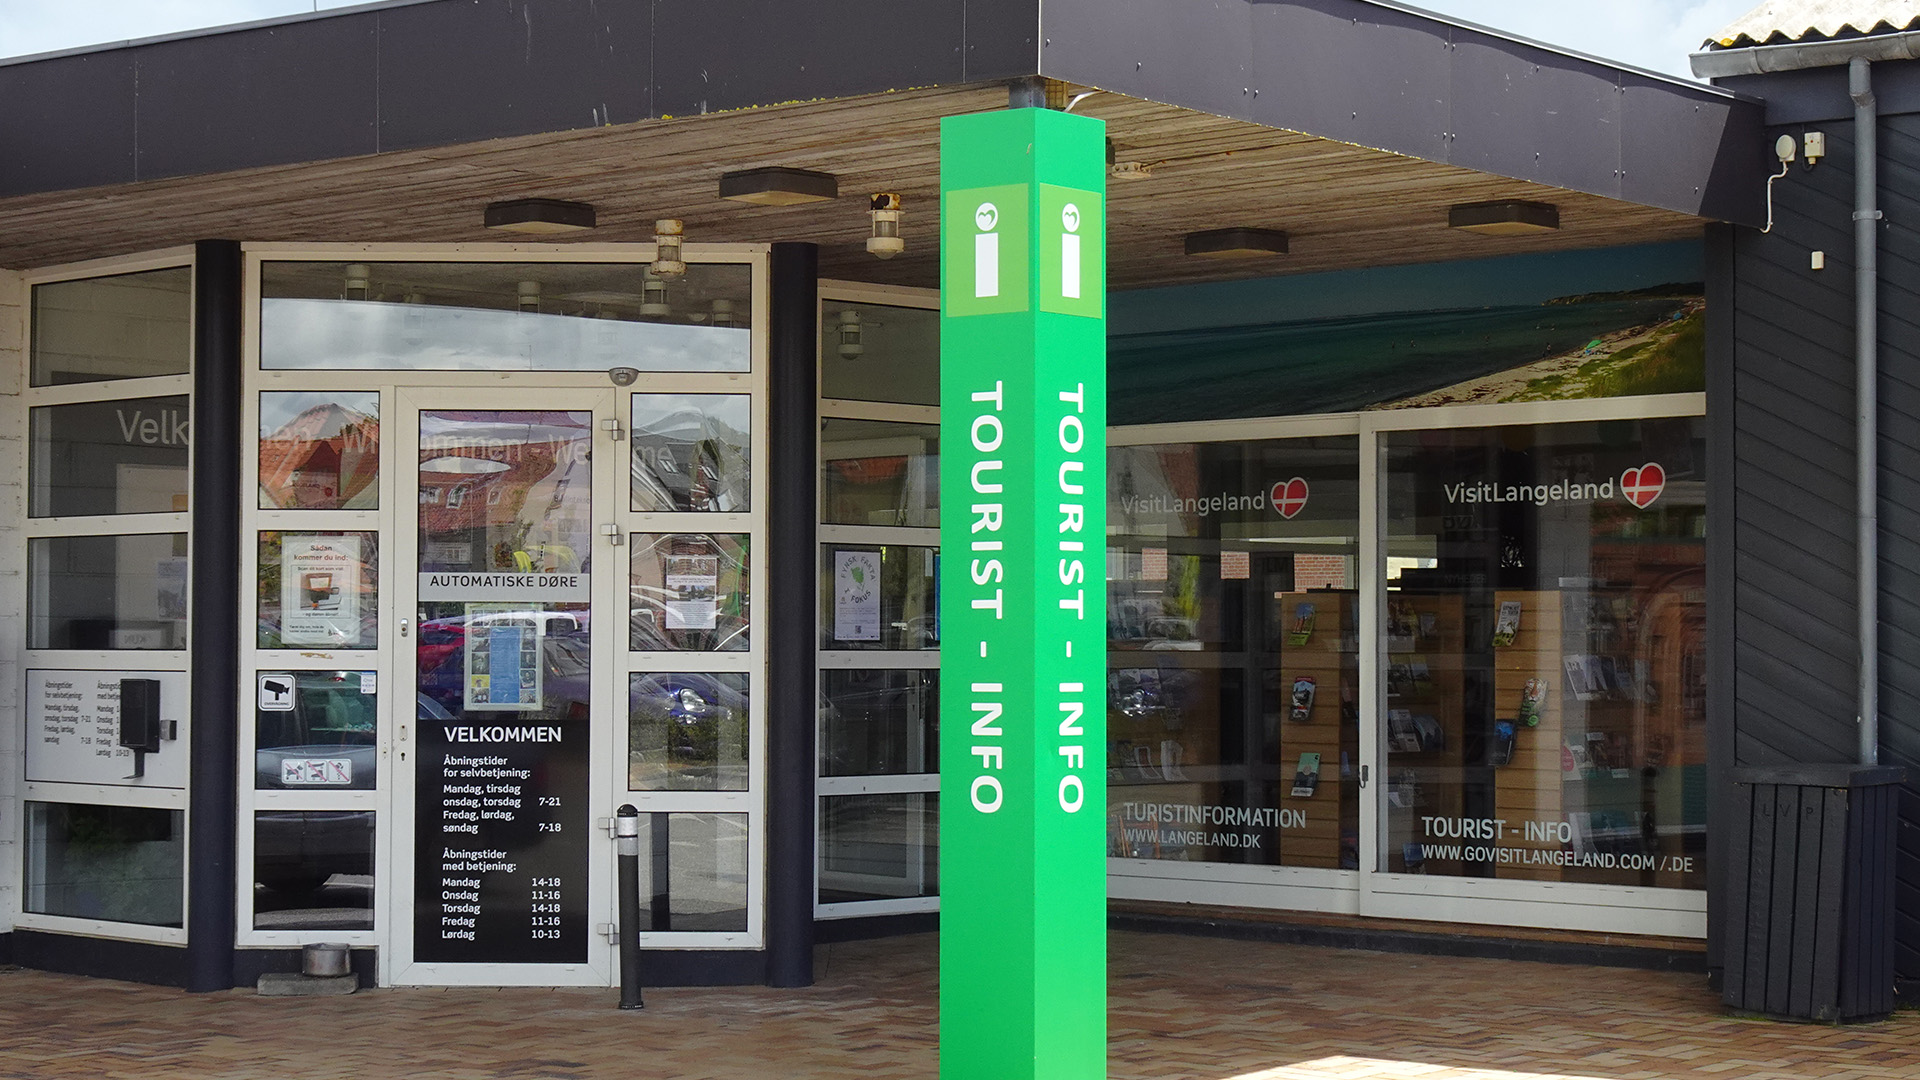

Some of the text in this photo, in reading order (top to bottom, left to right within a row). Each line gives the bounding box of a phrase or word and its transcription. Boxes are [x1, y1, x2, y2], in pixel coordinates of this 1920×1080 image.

[1444, 477, 1614, 506] VisitLangeland
[970, 380, 1003, 619] TOURIST
[1058, 382, 1084, 620] TOURIST
[1121, 490, 1265, 516] VisitLangeland
[430, 575, 578, 587] AUTOMATISKE DØRE
[850, 590, 871, 604] FOKUS
[444, 726, 562, 742] VELKOMMEN
[970, 682, 1003, 813] INFO
[1058, 682, 1084, 813] INFO
[443, 754, 508, 767] Åbningstider
[443, 768, 531, 780] for selvbetjening:
[443, 784, 521, 795] Mandag, tirsdag
[443, 797, 561, 808] onsdag, torsdag 7-21
[443, 810, 514, 821] Fredag, lørdag,
[1123, 802, 1306, 829] TURISTINFORMATION
[443, 823, 562, 834] søndag 7-18
[1422, 816, 1506, 840] TOURIST
[1524, 821, 1572, 843] INFO
[1123, 829, 1261, 849] WWW.LANGELAND.DK
[442, 847, 507, 860] Åbningstider
[1422, 844, 1655, 871] WWW.GOVISITLANGELAND.COM
[442, 862, 517, 873] med betjening:
[442, 878, 561, 889] Mandag 14-18
[442, 890, 561, 901] Onsdag 11-16
[442, 903, 561, 914] Torsdag 14-18
[442, 916, 561, 928] Fredag 11-16
[442, 930, 561, 941] Lørdag 10-13
